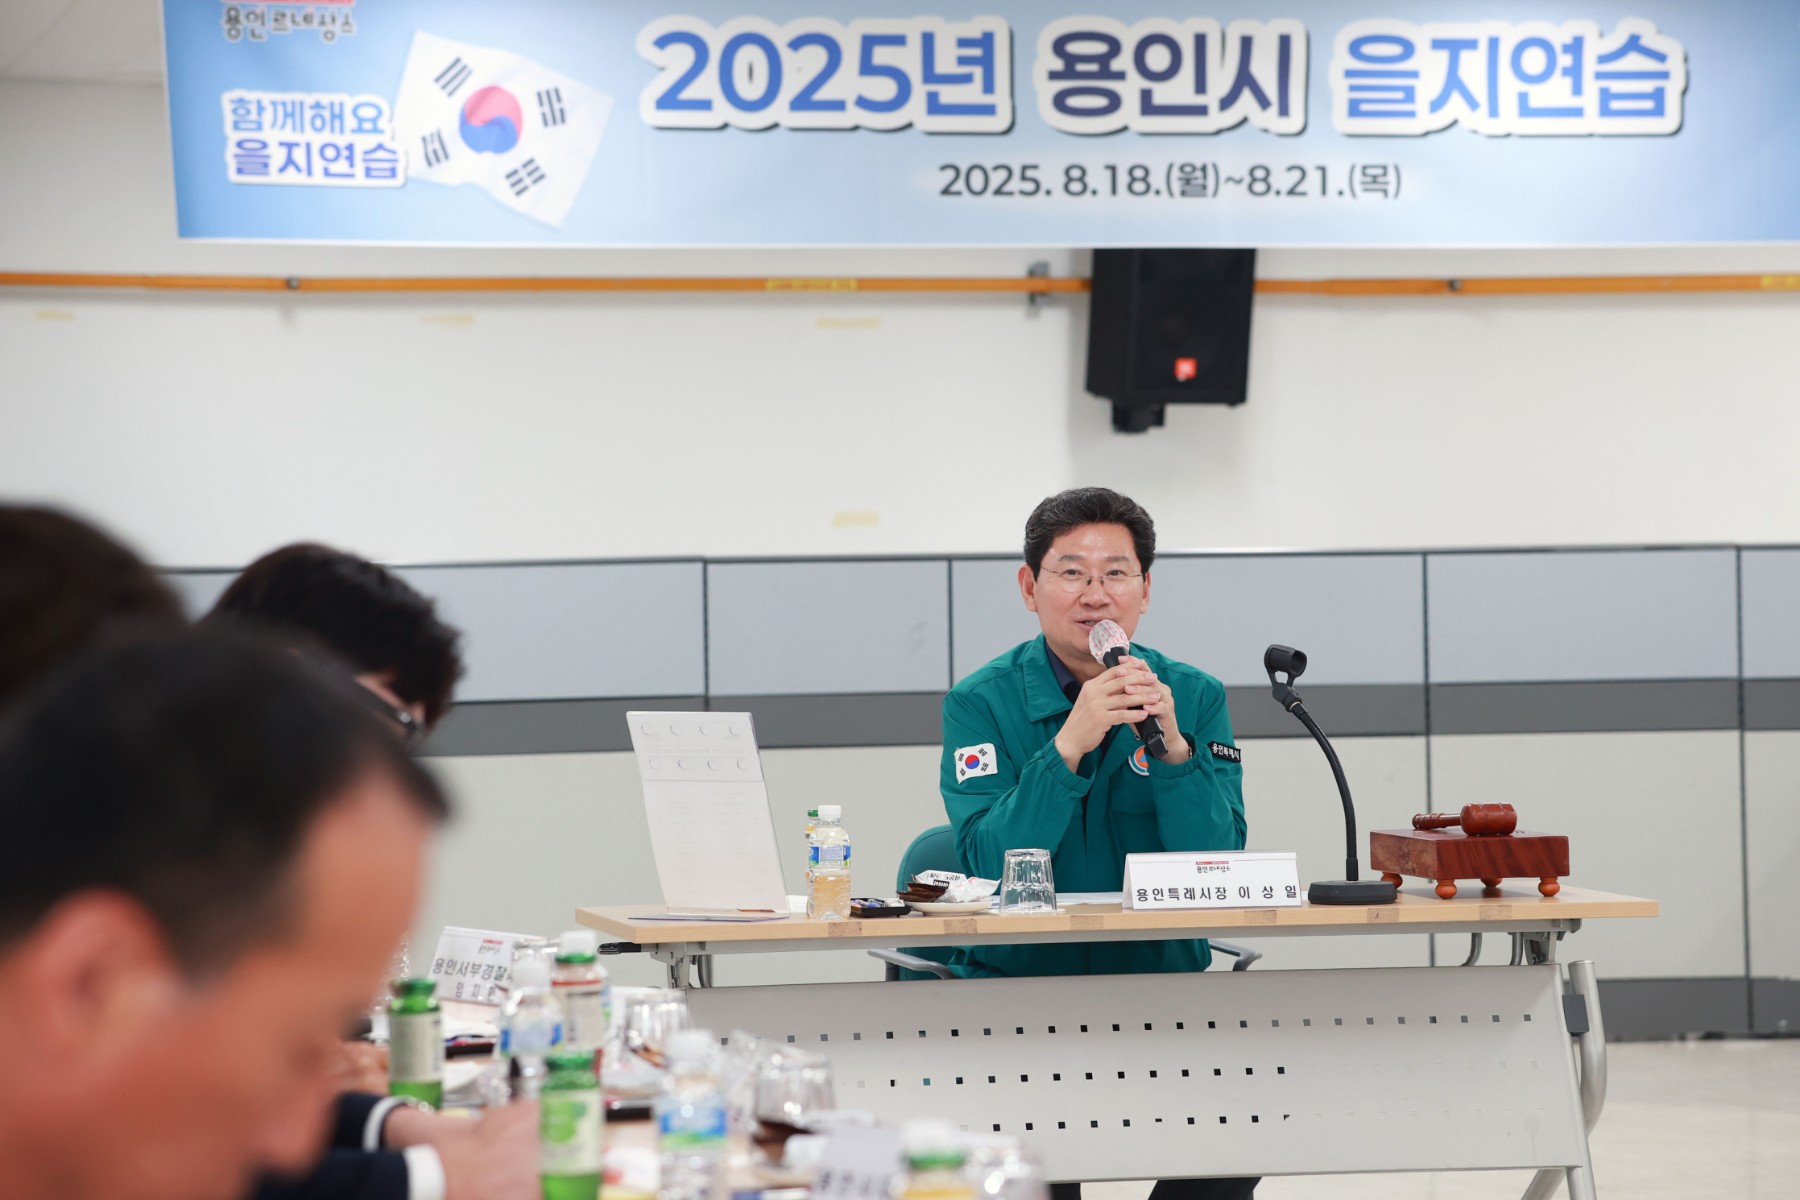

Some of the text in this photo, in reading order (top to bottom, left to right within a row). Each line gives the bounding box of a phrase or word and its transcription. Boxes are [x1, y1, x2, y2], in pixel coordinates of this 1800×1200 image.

[224, 6, 354, 41] 용인 르네상스
[652, 31, 1671, 119] 2025년 용인시 을지연습
[229, 97, 385, 134] 함께해요
[234, 139, 399, 179] 을지연습
[938, 162, 1402, 199] 2025. 8.18.(월)~8.21.(목)
[1136, 886, 1228, 902] 용인특례시장
